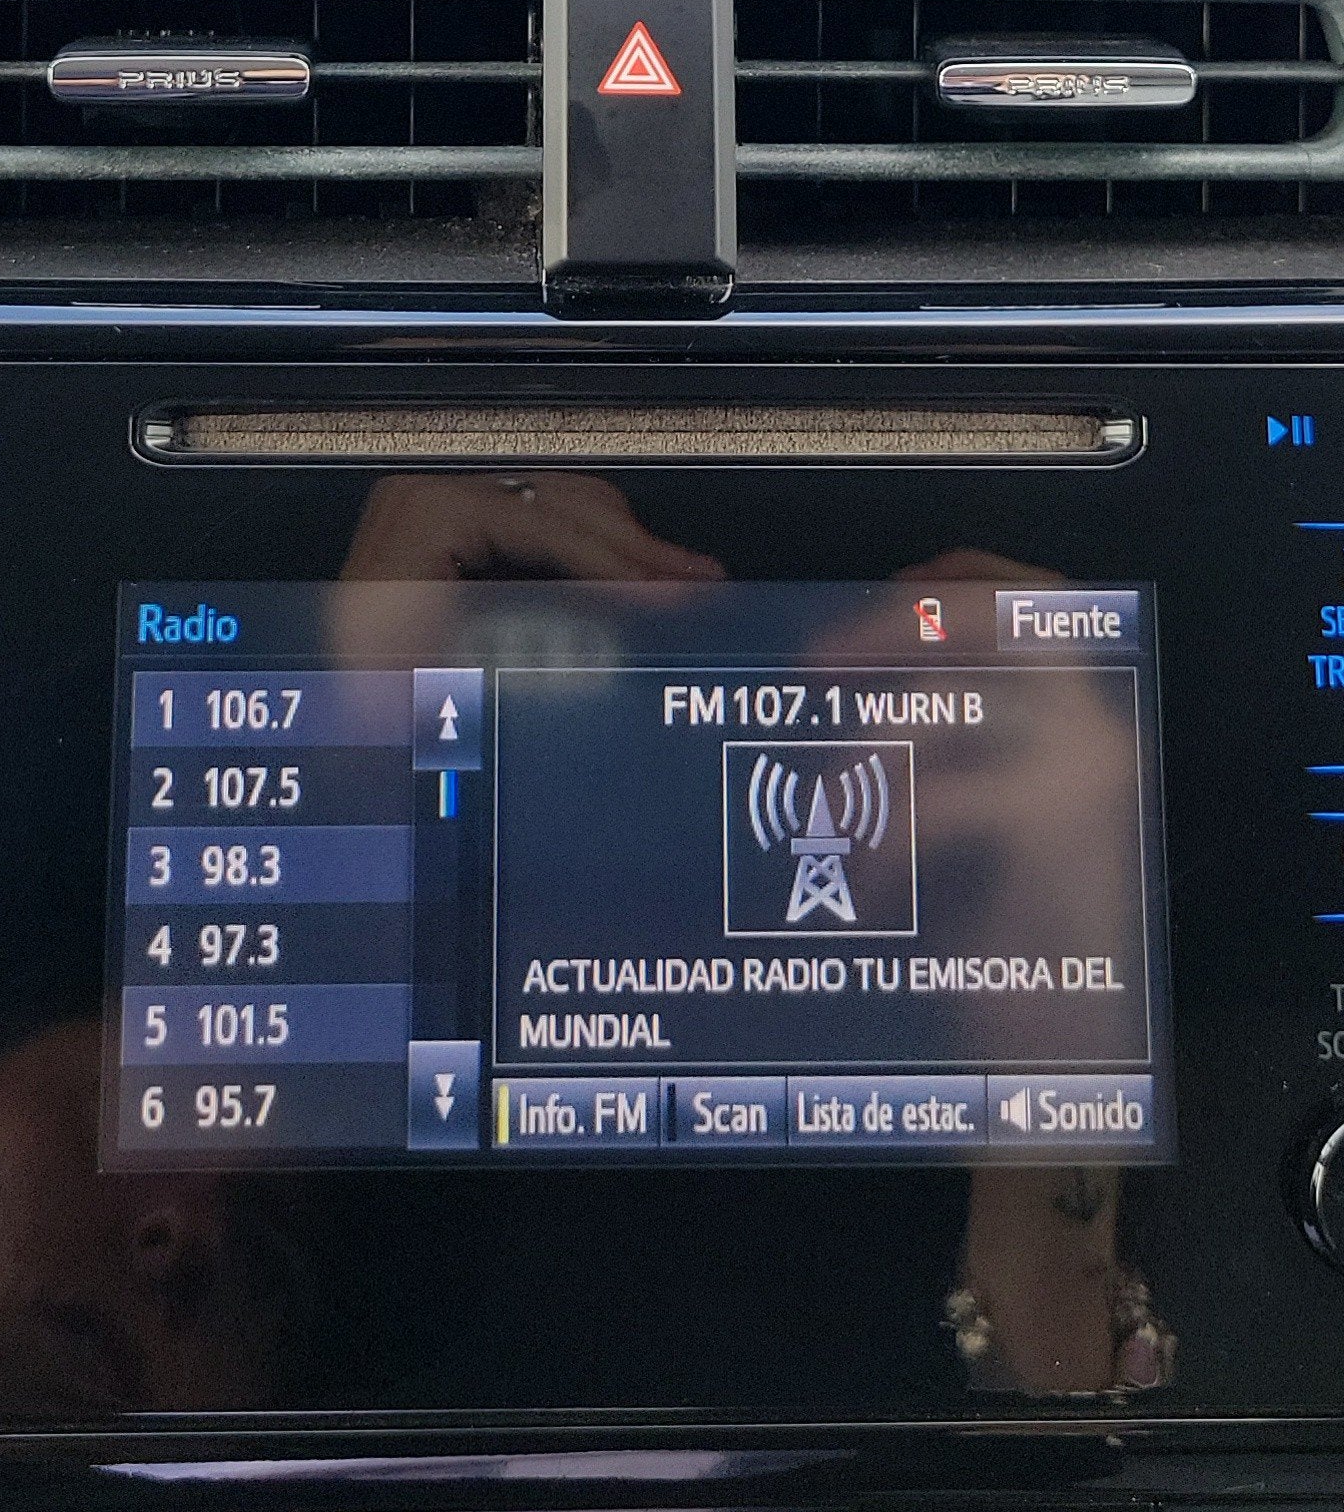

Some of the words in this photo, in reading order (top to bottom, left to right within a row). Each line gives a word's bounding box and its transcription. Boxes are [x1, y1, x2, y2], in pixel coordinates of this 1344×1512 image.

[118, 70, 241, 88] PRIUS
[137, 603, 239, 644] Radio
[1011, 600, 1122, 639] Fuente
[159, 689, 174, 730] 1
[206, 689, 302, 730] 106.7
[857, 692, 955, 725] WURN
[963, 692, 983, 724] B
[151, 767, 174, 808] 2
[204, 766, 301, 808] 107.5
[149, 845, 171, 887] 3
[202, 844, 281, 886] 98.3
[147, 925, 171, 966] 4
[200, 924, 279, 966] 97.3
[522, 959, 734, 993] ACTUALIDAD
[741, 958, 846, 992] RADIO
[853, 958, 900, 991] TU
[909, 957, 1053, 990] EMISORA
[1061, 956, 1123, 990] DEL
[144, 1005, 167, 1047] 5
[198, 1004, 288, 1046] 101.5
[519, 1013, 671, 1049] MUNDIAL
[141, 1086, 165, 1127] 6
[195, 1085, 276, 1127] 95.7
[519, 1093, 584, 1136] Info.
[595, 1093, 647, 1134] FM
[693, 1093, 767, 1134] Scan
[797, 1092, 854, 1134] Lista
[862, 1092, 894, 1132] de
[902, 1093, 975, 1132] estac.
[1038, 1091, 1143, 1131] Sonido
